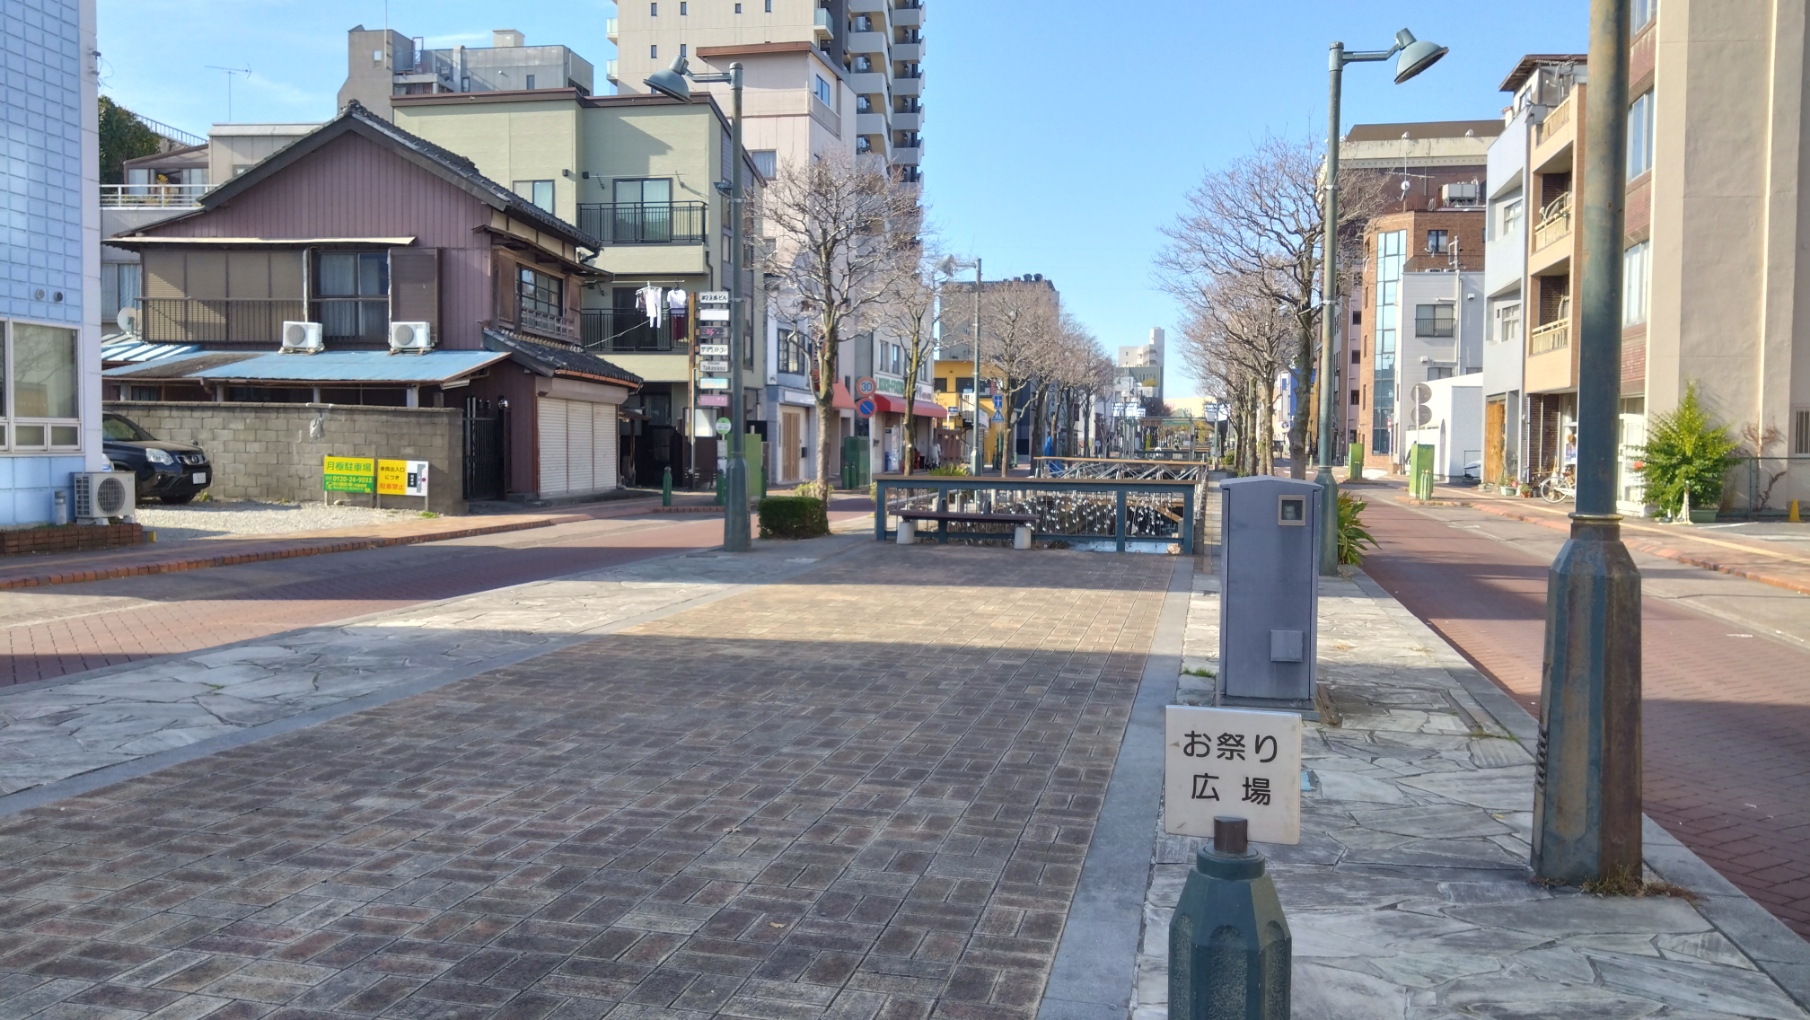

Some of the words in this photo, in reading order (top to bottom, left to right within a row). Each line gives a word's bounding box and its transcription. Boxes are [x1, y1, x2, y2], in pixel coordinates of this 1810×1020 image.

[861, 382, 873, 392] 30
[327, 461, 372, 472] 月極駐車場
[1183, 730, 1278, 763] お祭り
[1191, 772, 1271, 806] 広場
